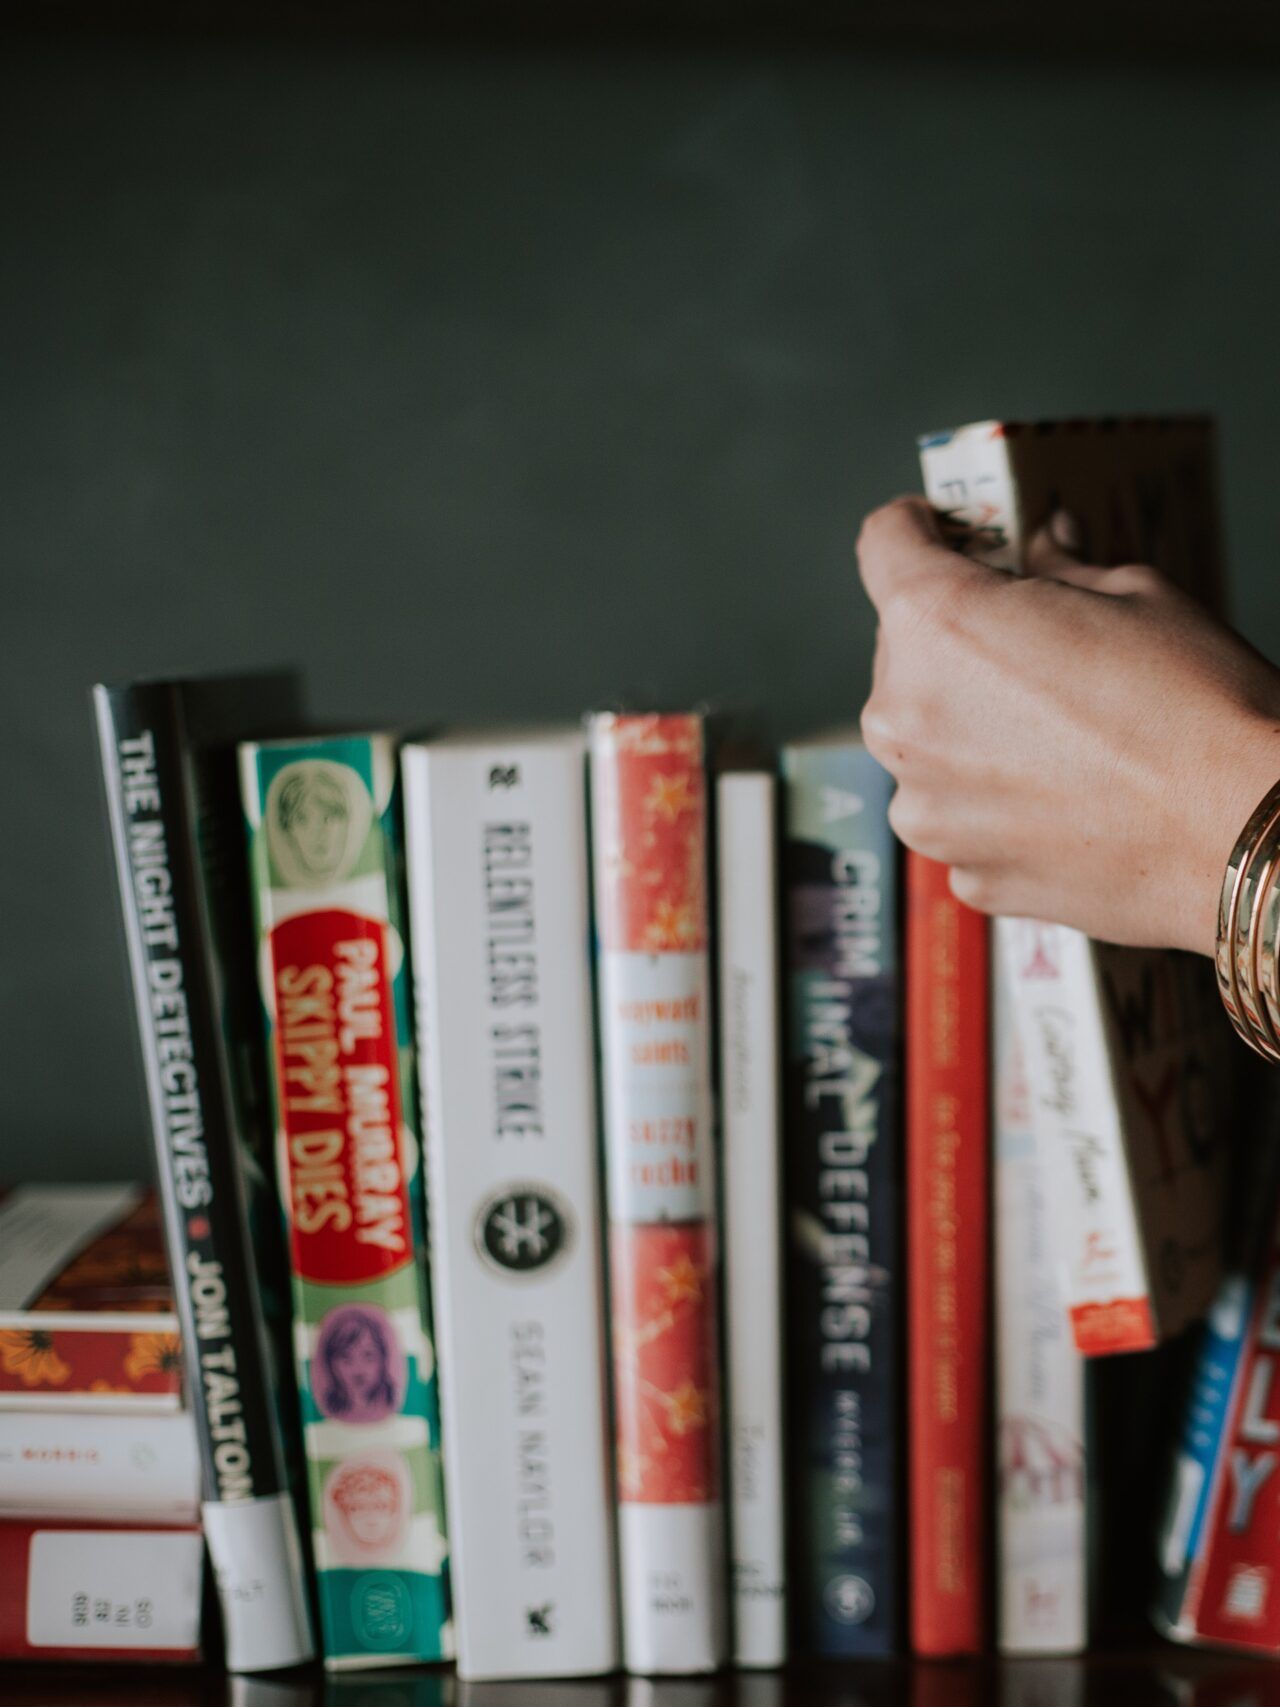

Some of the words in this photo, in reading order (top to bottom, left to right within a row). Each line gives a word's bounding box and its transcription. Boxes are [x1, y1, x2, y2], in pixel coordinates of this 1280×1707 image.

[119, 730, 160, 811] THE
[129, 817, 180, 958] NIGHT
[483, 821, 540, 1009] RELENTLESS
[278, 965, 345, 1112] SKIPPY
[332, 938, 384, 1052] PAUL
[148, 965, 212, 1208] DETECTIVES
[493, 1023, 544, 1140] STRIKE
[289, 1133, 351, 1234] DIES
[344, 1065, 406, 1252] MURRAY
[187, 1250, 230, 1341] JON
[817, 1130, 871, 1375] DEFENSE
[201, 1352, 255, 1502] TALTON
[510, 1321, 547, 1418] SEAN
[516, 1430, 556, 1572] NAYLOR
